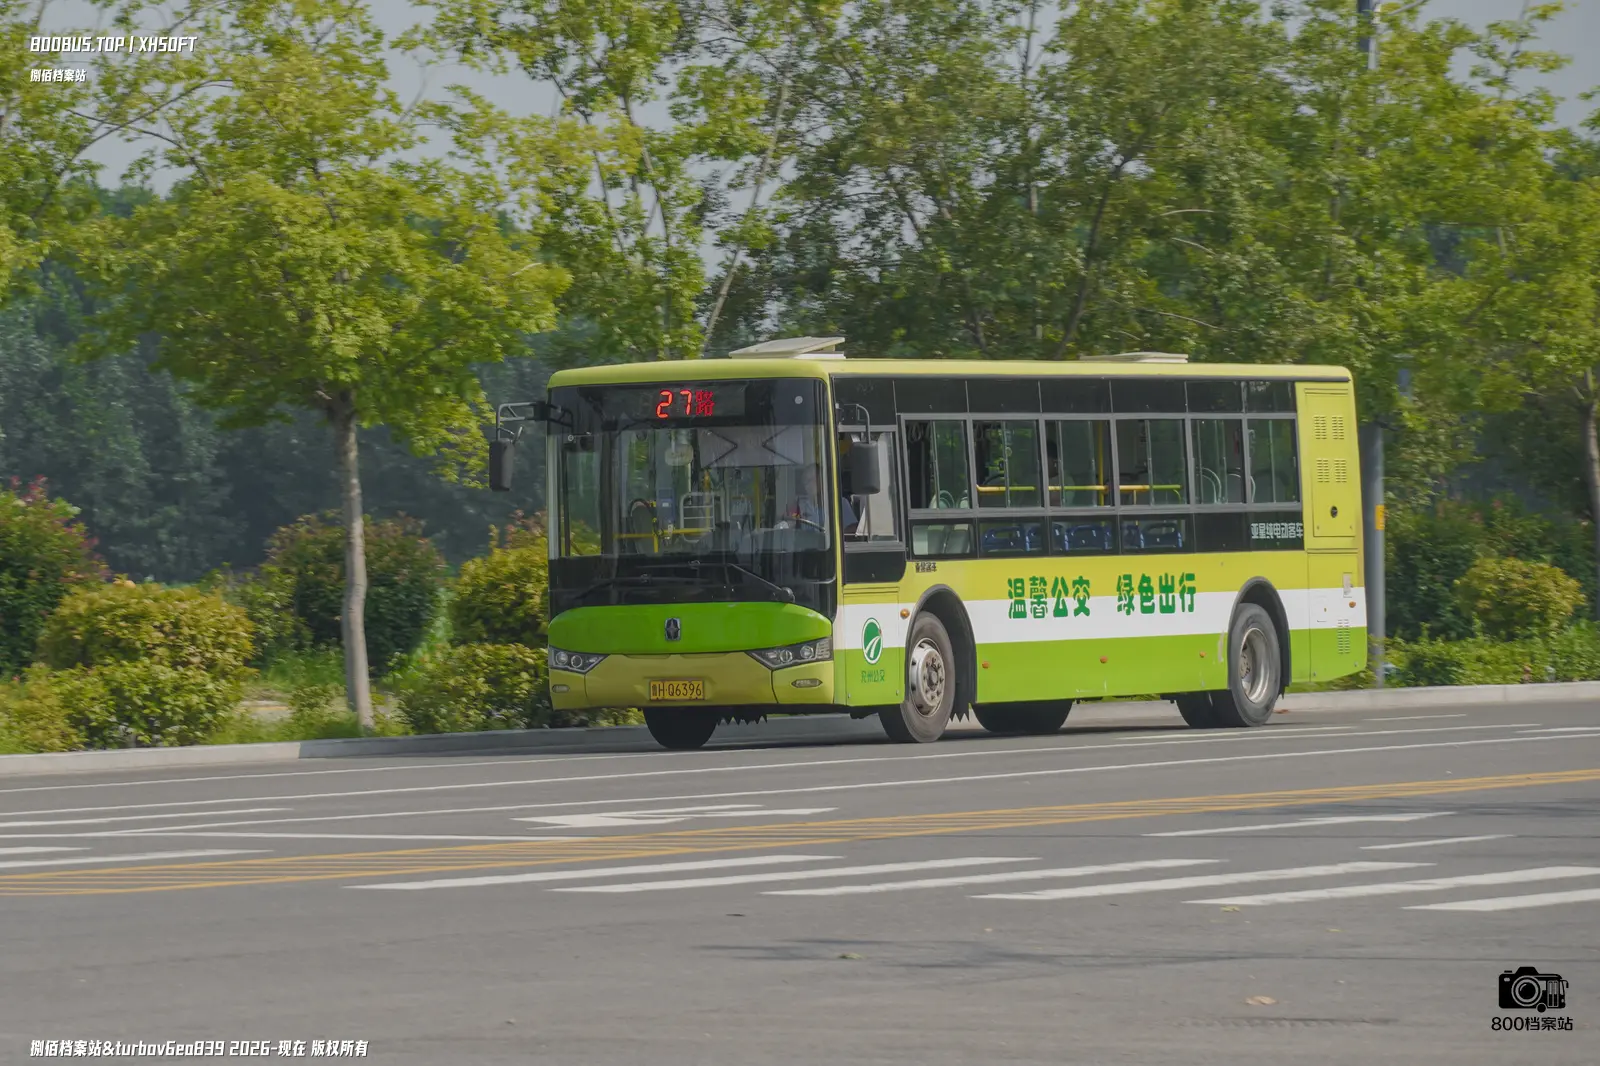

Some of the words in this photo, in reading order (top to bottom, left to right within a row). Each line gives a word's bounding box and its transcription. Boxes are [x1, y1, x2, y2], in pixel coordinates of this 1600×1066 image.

[656, 389, 715, 418] 27路
[1007, 575, 1091, 620] 温馨公交
[1116, 572, 1197, 616] 绿色出行
